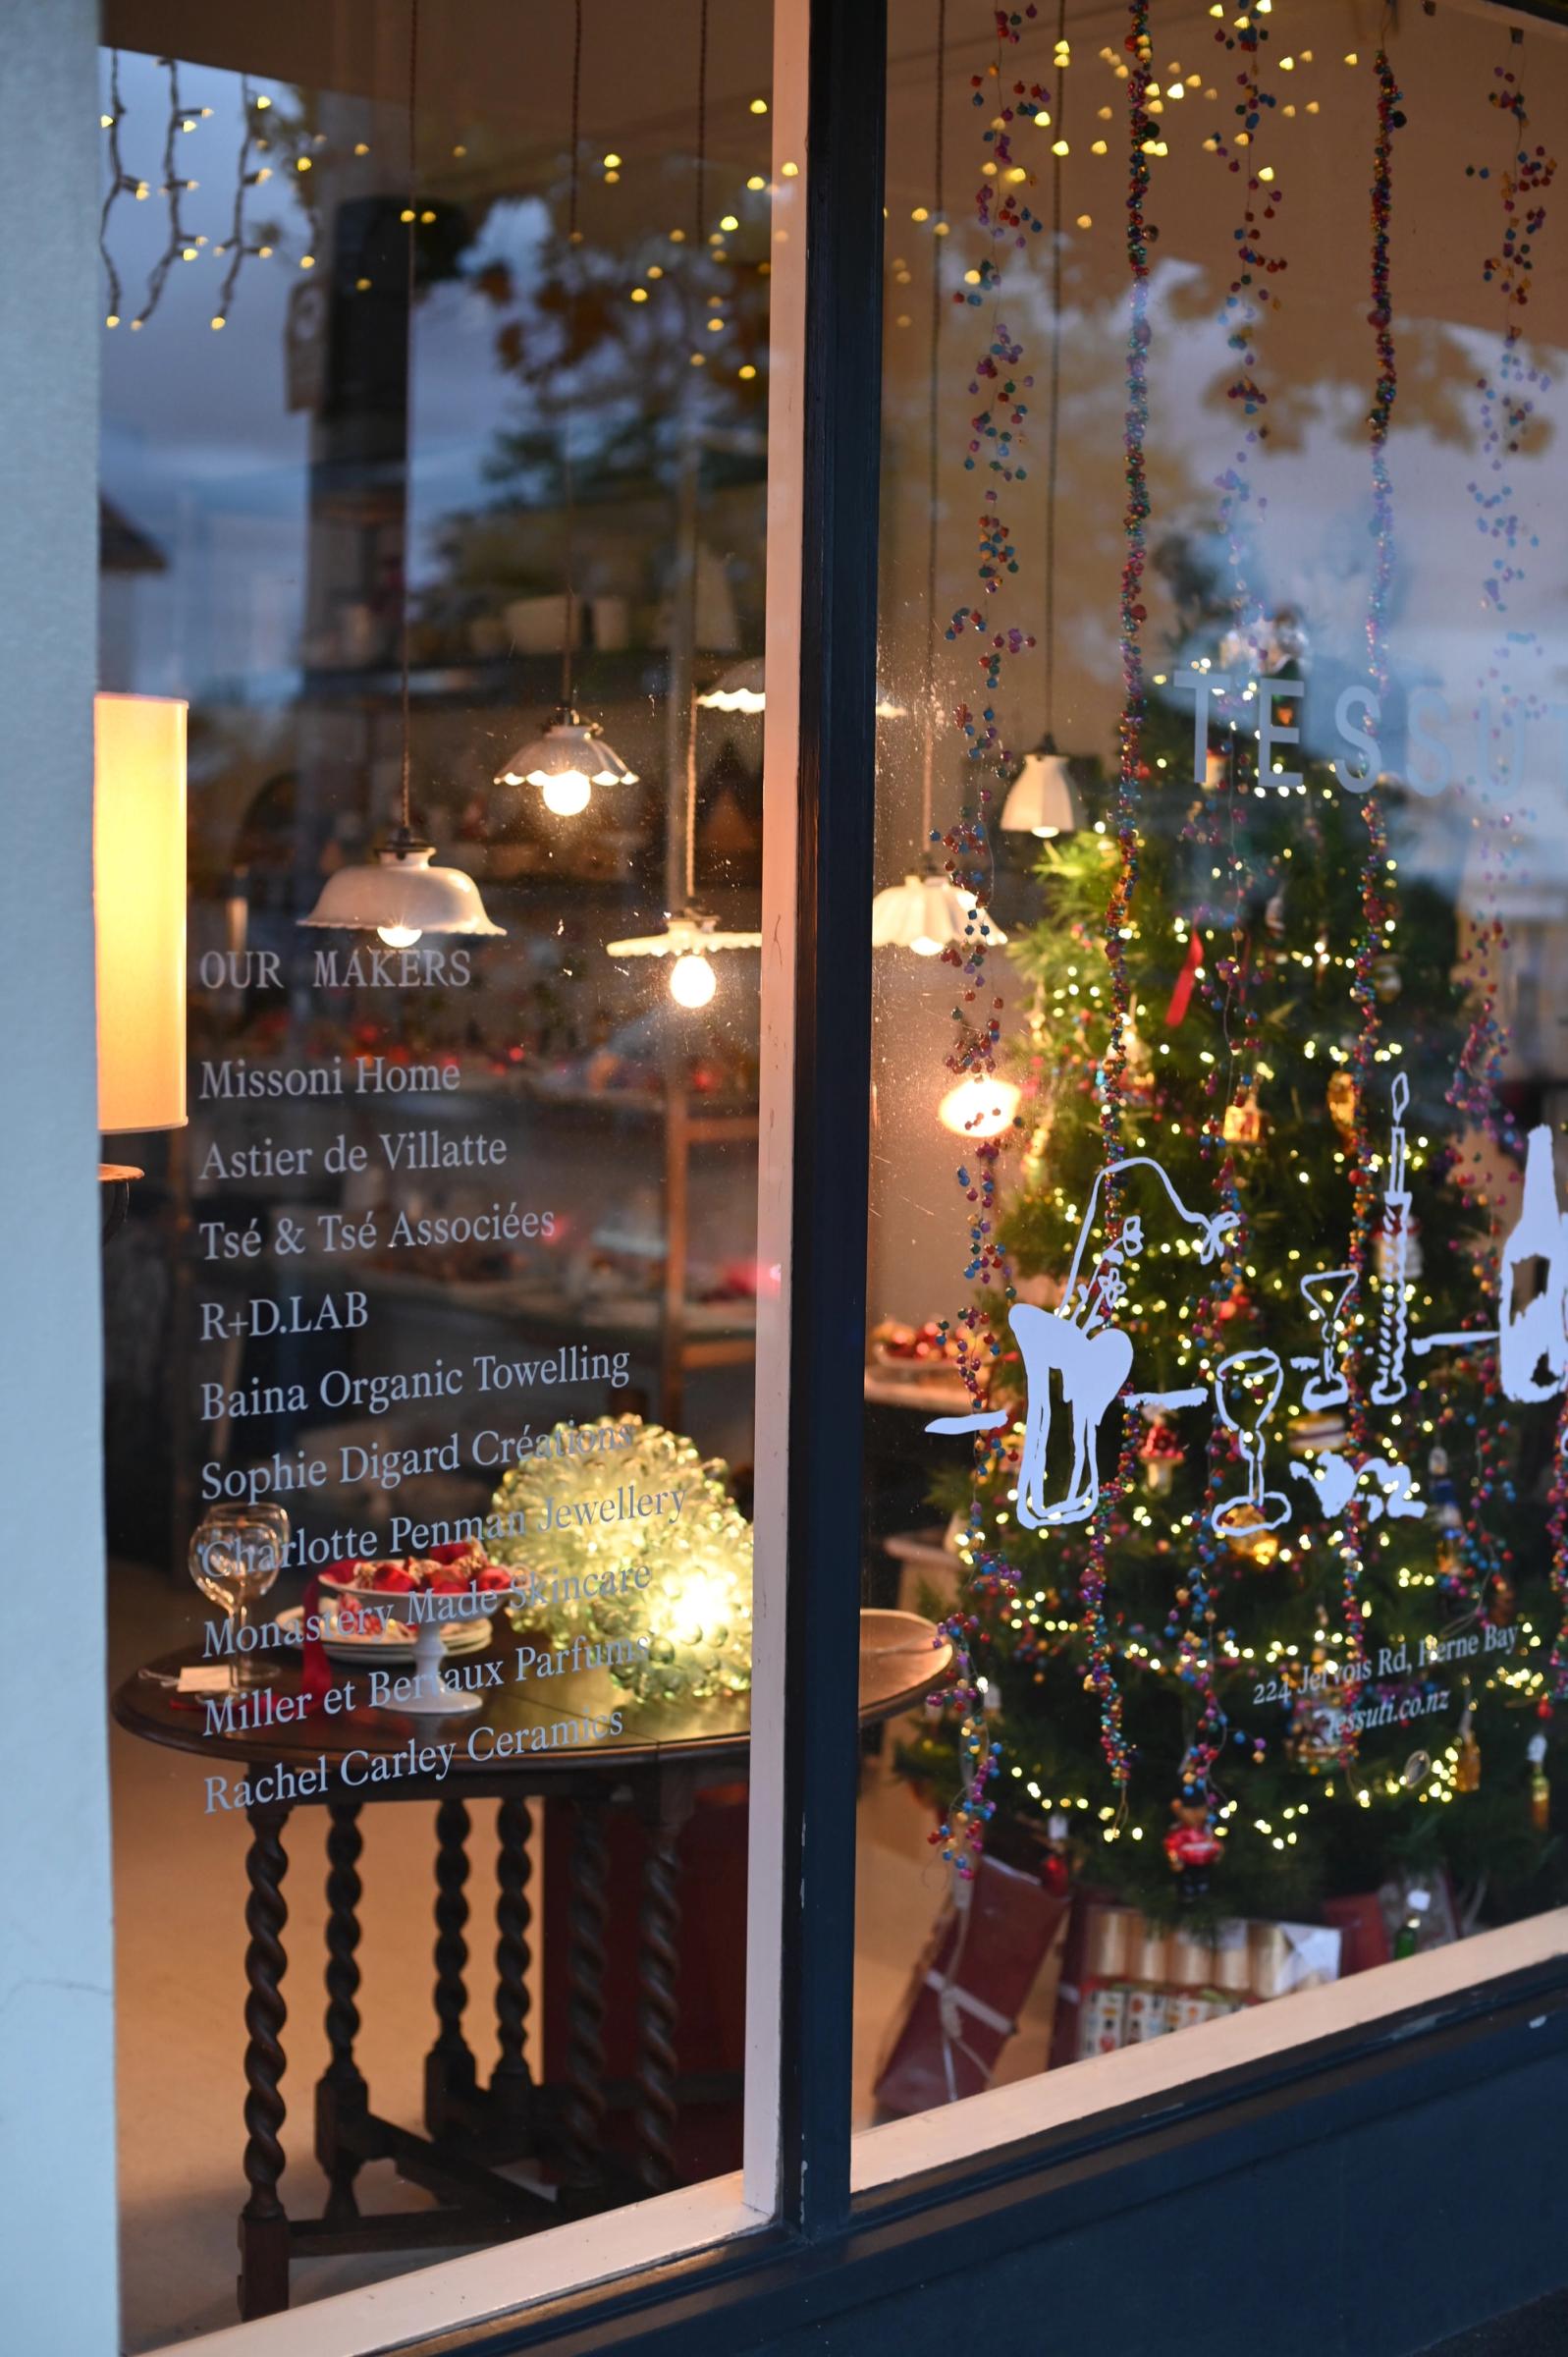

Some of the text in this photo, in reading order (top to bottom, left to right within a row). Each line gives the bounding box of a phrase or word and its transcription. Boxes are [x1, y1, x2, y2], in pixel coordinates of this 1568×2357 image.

[199, 949, 471, 990] OUR MAKERS
[198, 1056, 460, 1099] Missoni Home
[199, 1130, 508, 1178] Astier de Villatte
[199, 1202, 555, 1260] Tsé & Tsé Associées
[199, 1290, 369, 1341] R+D.LAB
[200, 1344, 630, 1421] Baina Organic Towelling
[201, 1418, 634, 1506] Sophie Digard Créations
[201, 1485, 687, 1577] Charlotte Penman Jewellery
[202, 1562, 652, 1658] Monastery Made Skincare
[202, 1688, 312, 1737] Miller
[323, 1682, 356, 1712] et
[515, 1634, 650, 1681] Parfums
[1253, 1680, 1292, 1705] 224
[1378, 1642, 1413, 1677] Rd,
[1484, 1623, 1520, 1655] Bay
[204, 1705, 623, 1814] Rachel Carley Ceramics
